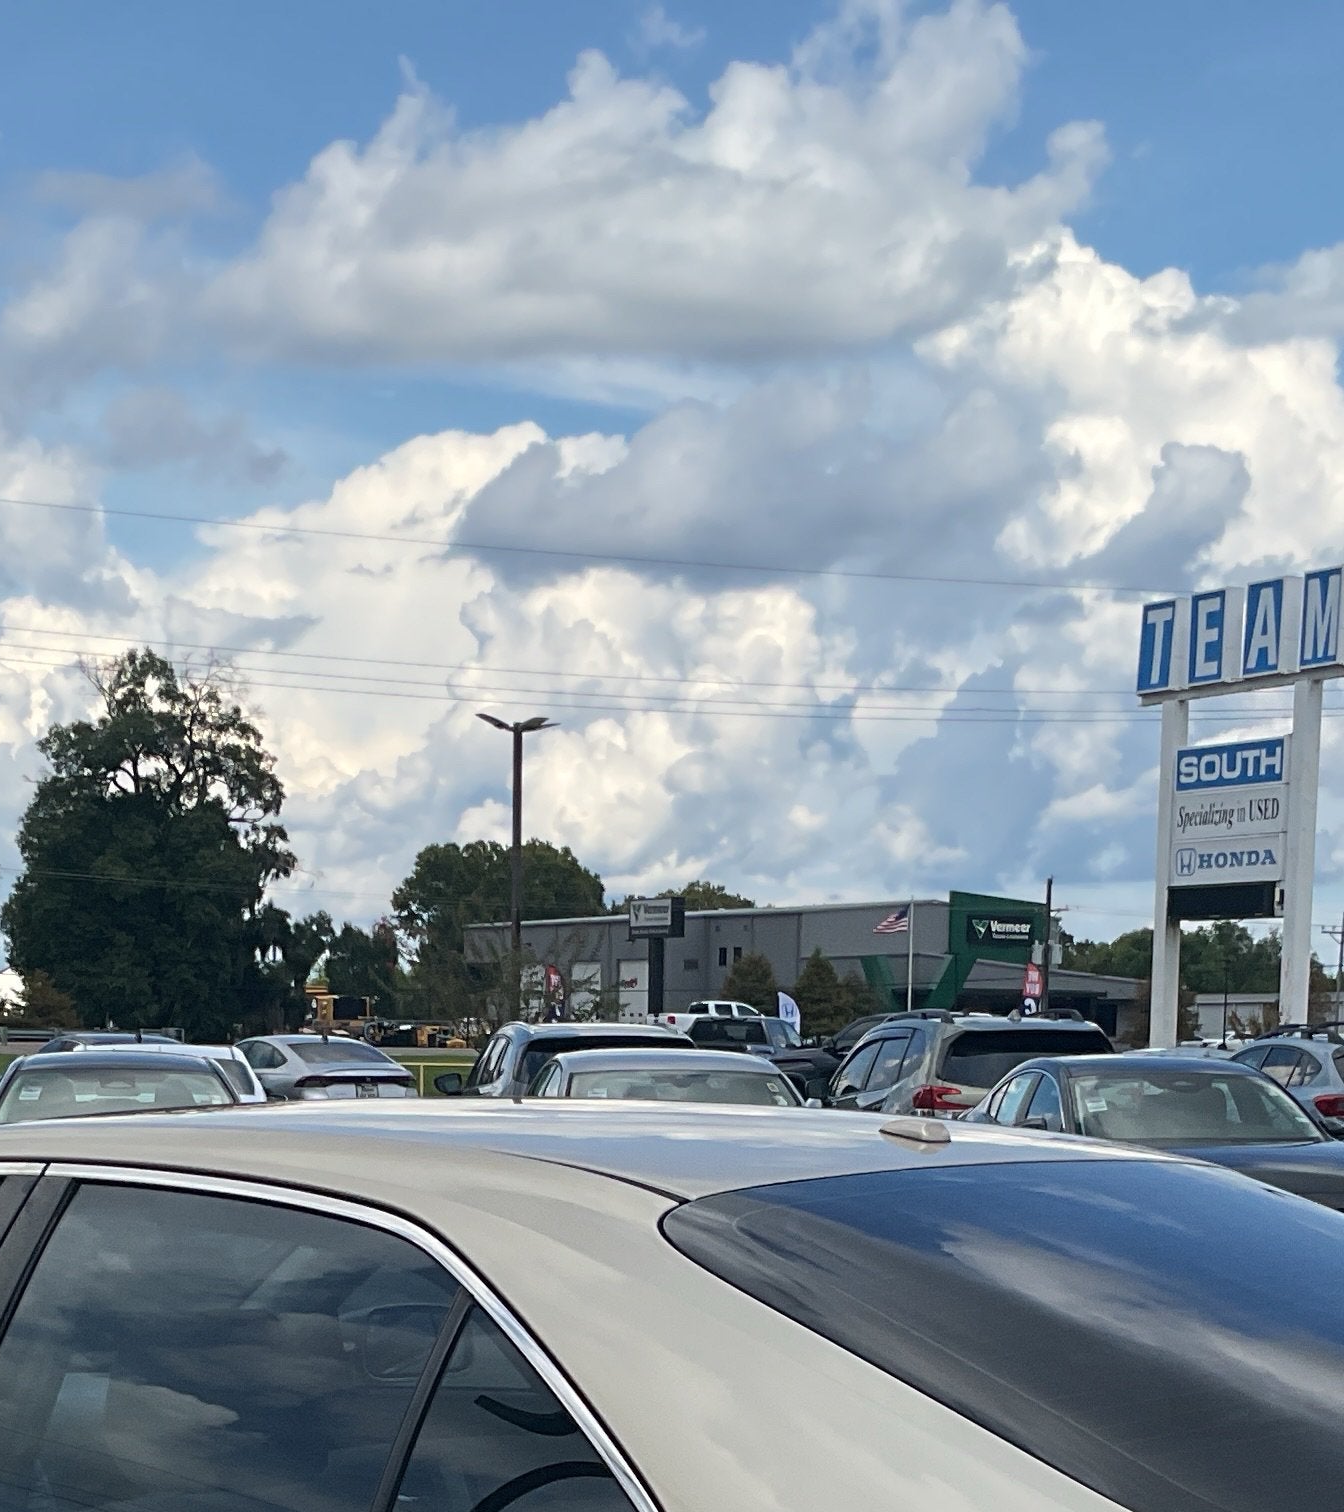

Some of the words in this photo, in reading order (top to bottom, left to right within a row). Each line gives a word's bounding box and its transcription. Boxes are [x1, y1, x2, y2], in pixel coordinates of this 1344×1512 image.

[1146, 574, 1341, 684] TEAM
[1178, 747, 1282, 784] SOUTH
[1177, 802, 1234, 833] Specializing
[1249, 798, 1279, 821] USED
[1197, 849, 1277, 869] HONDA
[990, 920, 1031, 933] Vermeer
